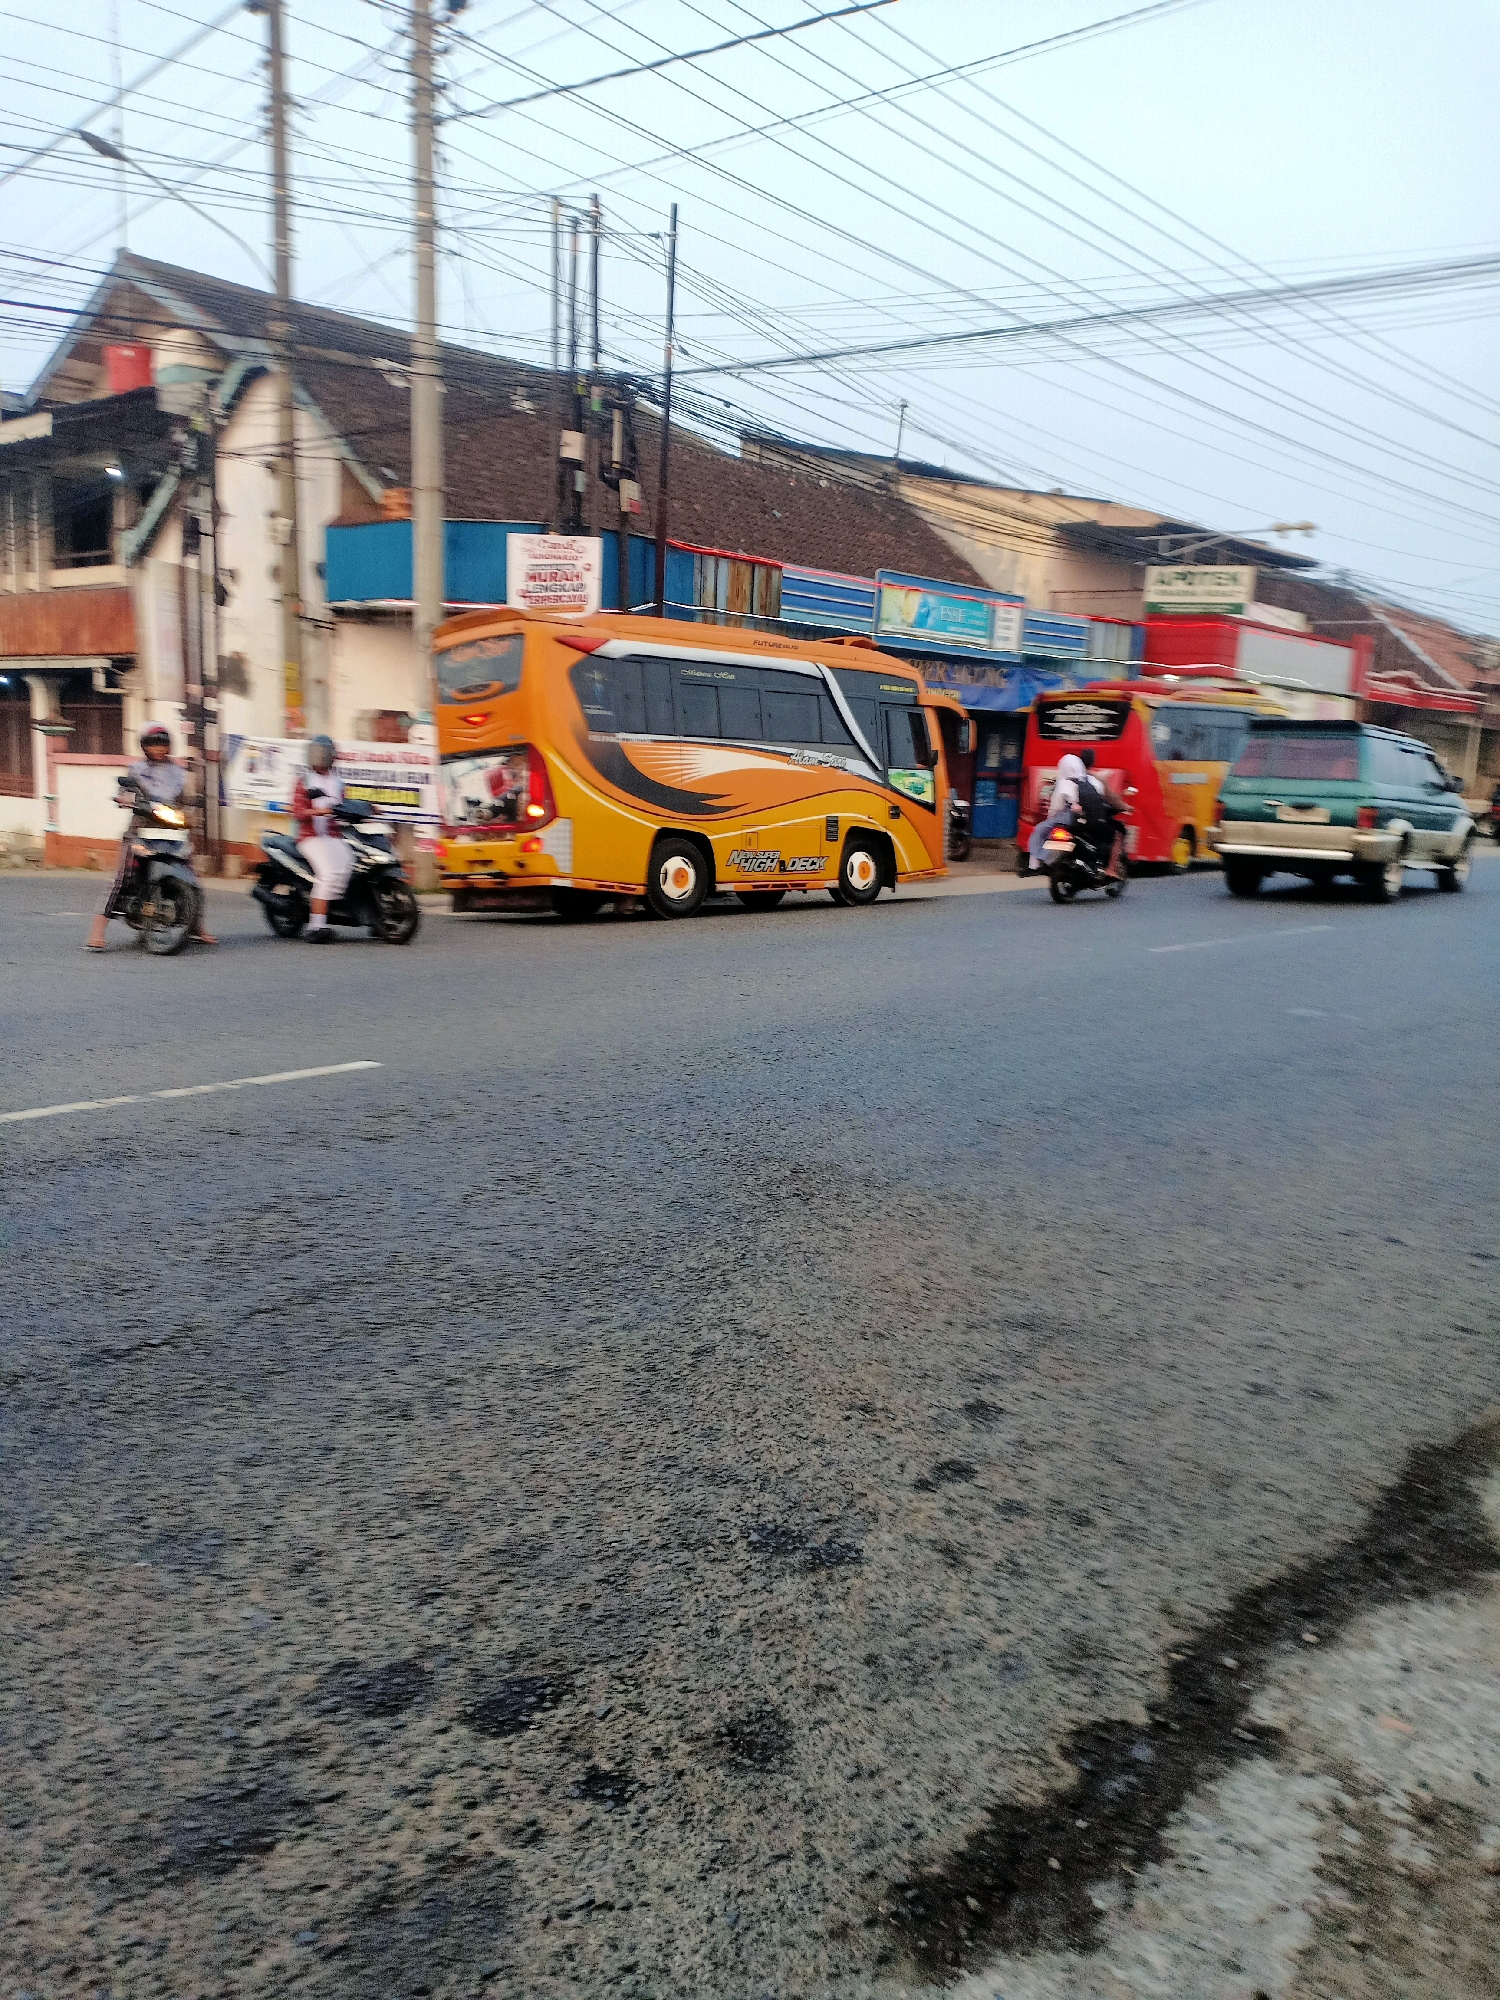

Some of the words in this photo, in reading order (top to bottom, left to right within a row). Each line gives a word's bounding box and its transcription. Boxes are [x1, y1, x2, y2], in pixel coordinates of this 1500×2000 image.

[753, 640, 782, 649] FUTURE
[787, 749, 819, 766] Alam
[726, 849, 756, 866] NEW
[756, 850, 780, 860] SUPER
[736, 858, 779, 872] HIGH
[785, 855, 829, 872] DECK
